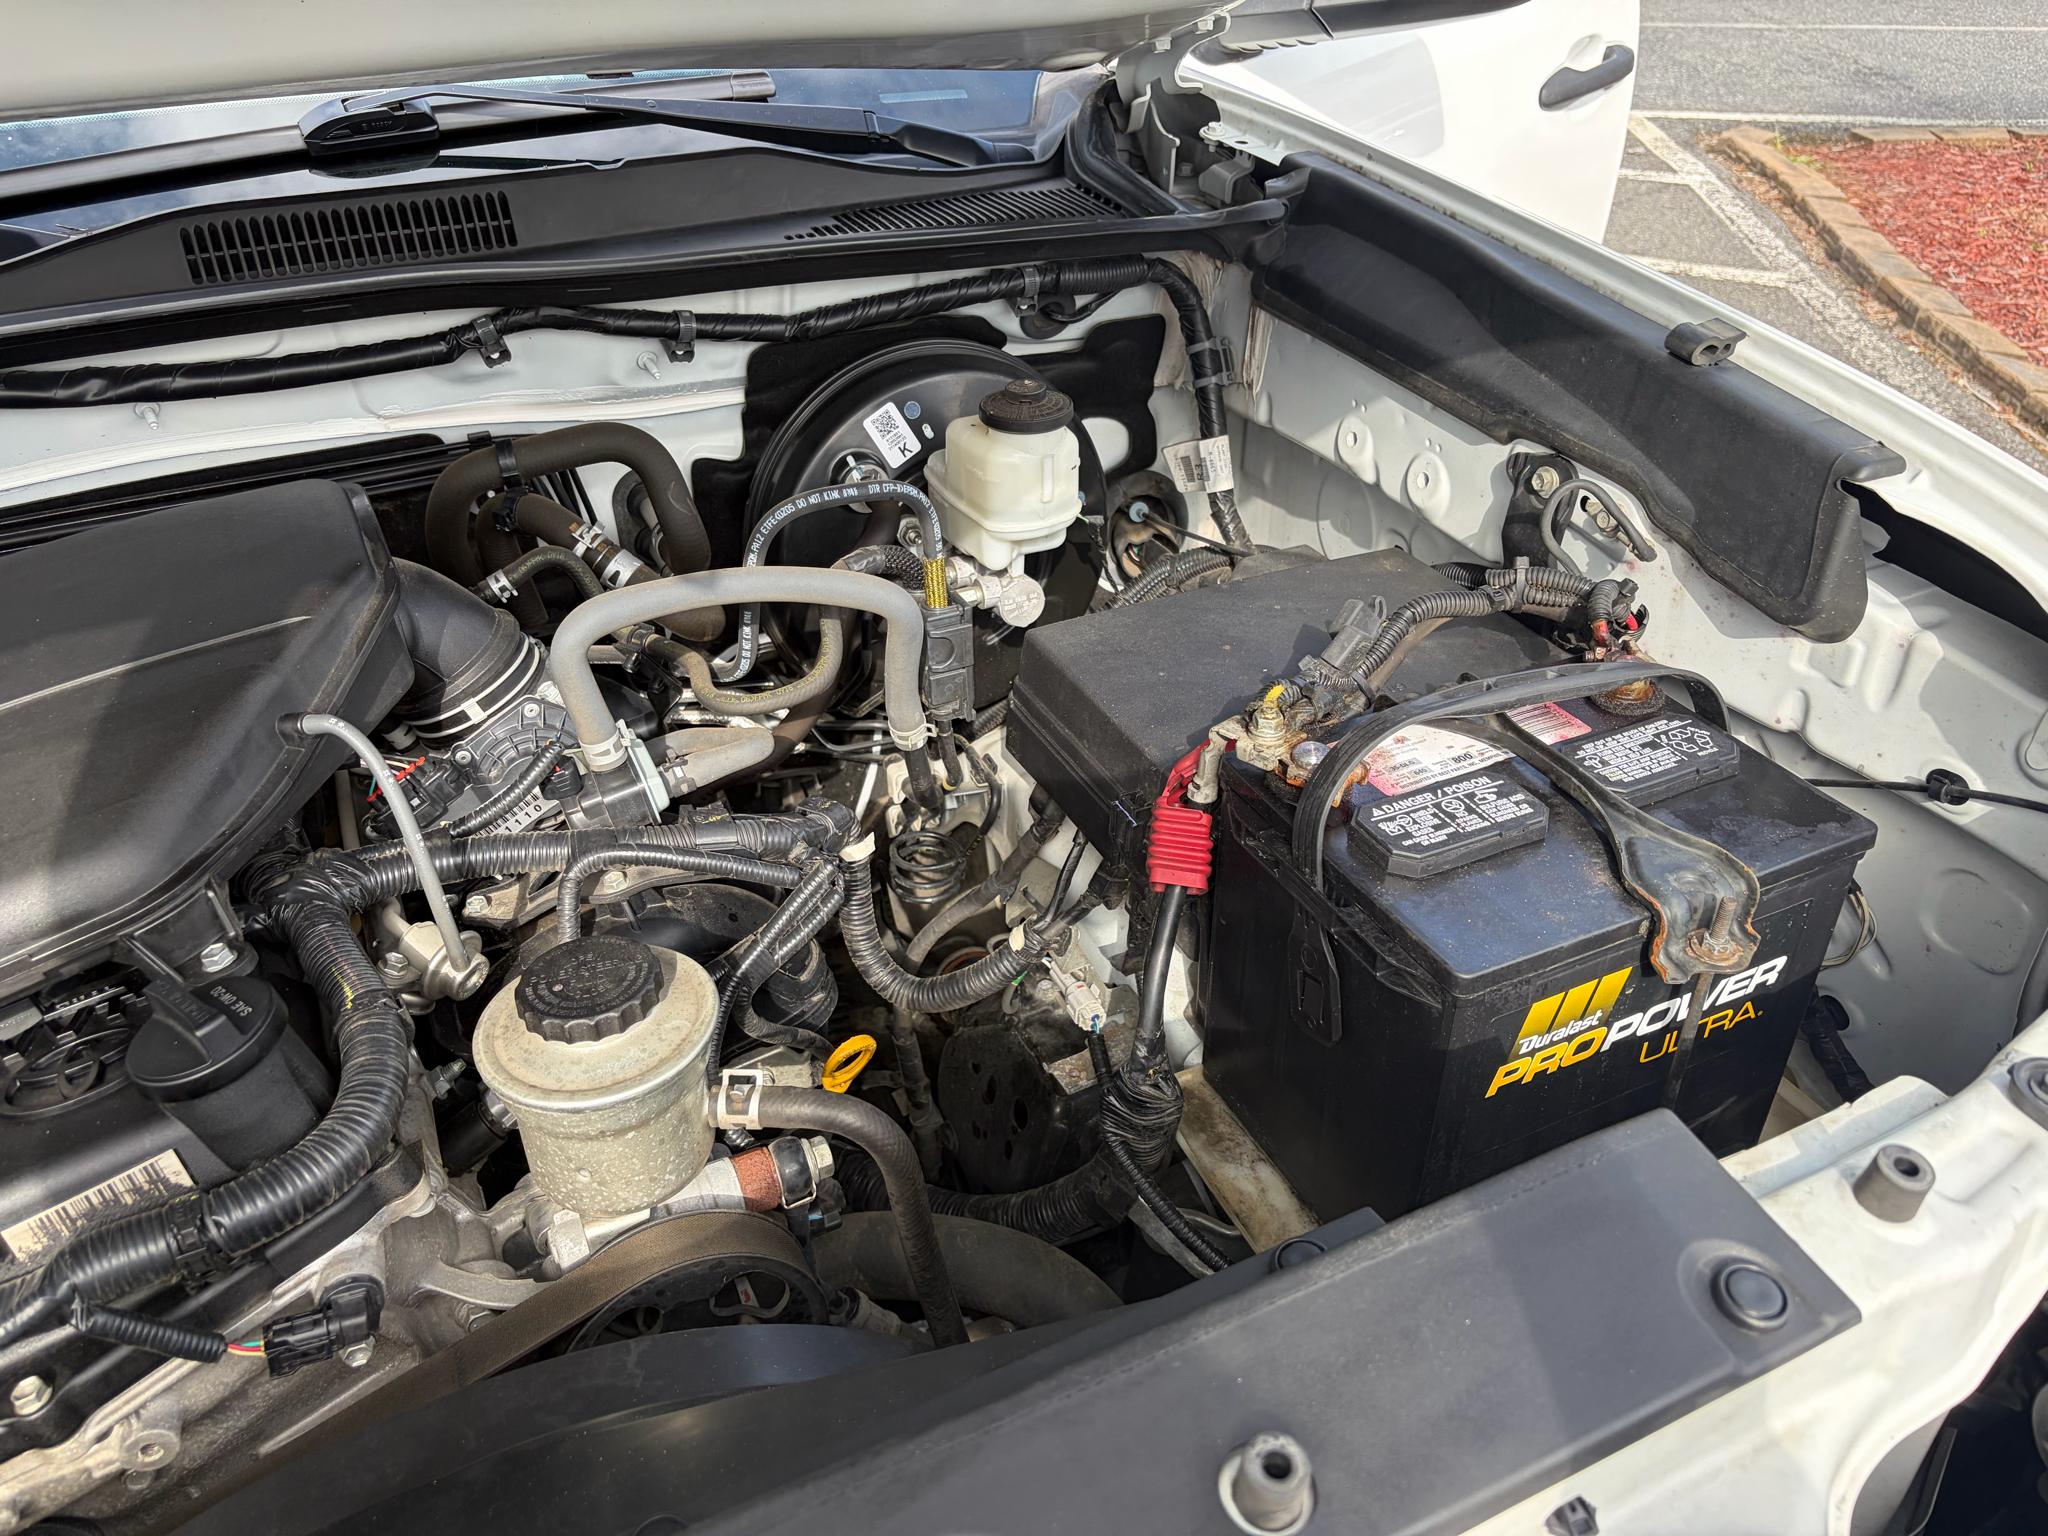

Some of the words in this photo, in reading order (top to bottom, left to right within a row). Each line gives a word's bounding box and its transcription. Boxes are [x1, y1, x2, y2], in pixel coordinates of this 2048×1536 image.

[898, 442, 913, 458] K
[795, 497, 807, 509] DO
[807, 493, 821, 505] NOT
[823, 489, 840, 501] KINK
[1451, 752, 1473, 764] 800
[1381, 792, 1435, 813] DANGER
[1443, 775, 1492, 795] POISON
[232, 1000, 253, 1017] SAE
[1518, 1009, 1603, 1055] Duralast
